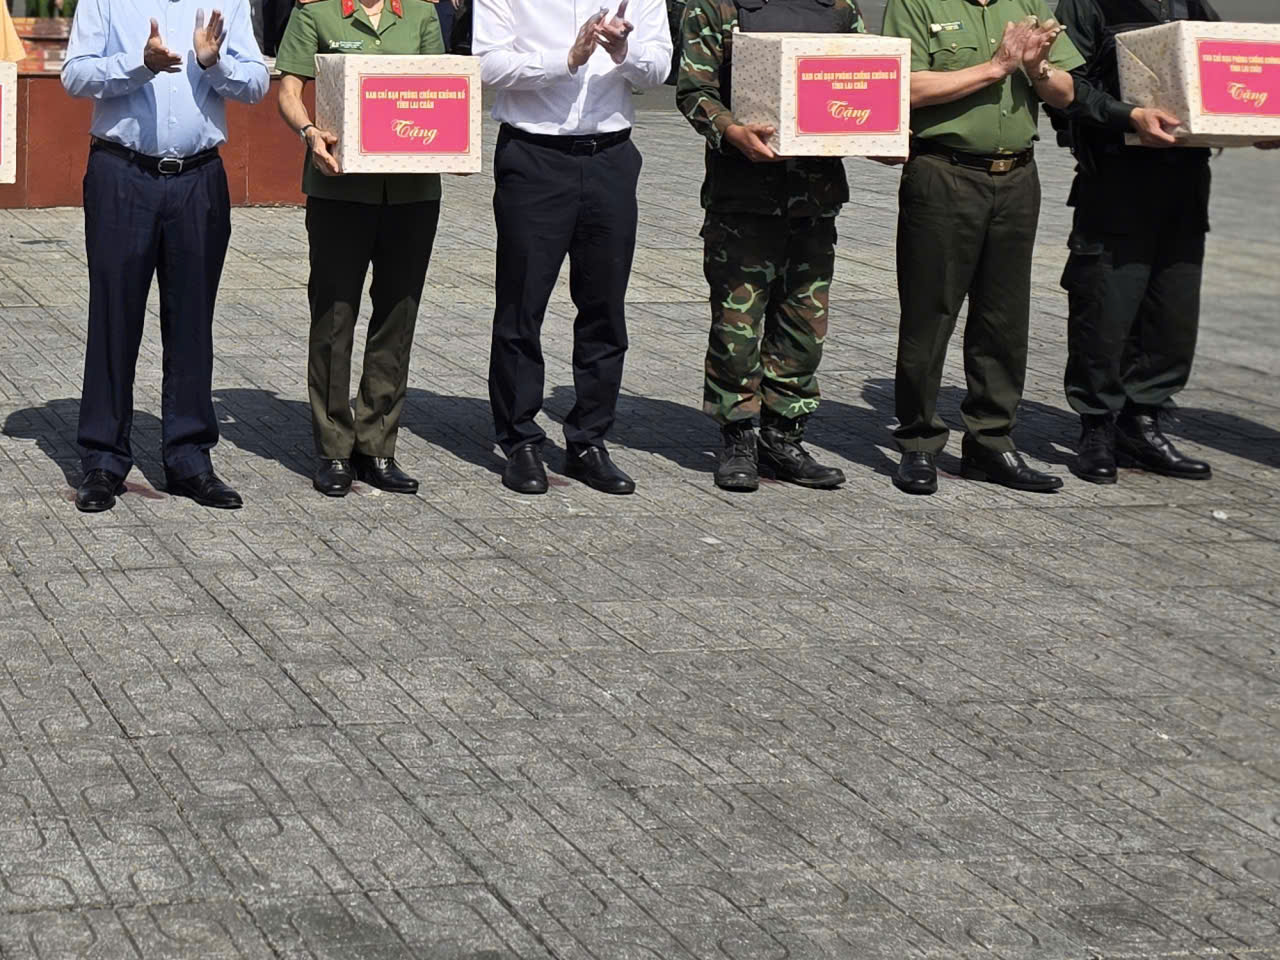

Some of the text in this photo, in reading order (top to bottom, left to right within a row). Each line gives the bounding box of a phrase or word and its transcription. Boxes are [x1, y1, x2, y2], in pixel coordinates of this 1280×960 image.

[1227, 81, 1268, 108] Tặng
[826, 99, 871, 126] Tặng
[391, 118, 438, 145] Tặng
